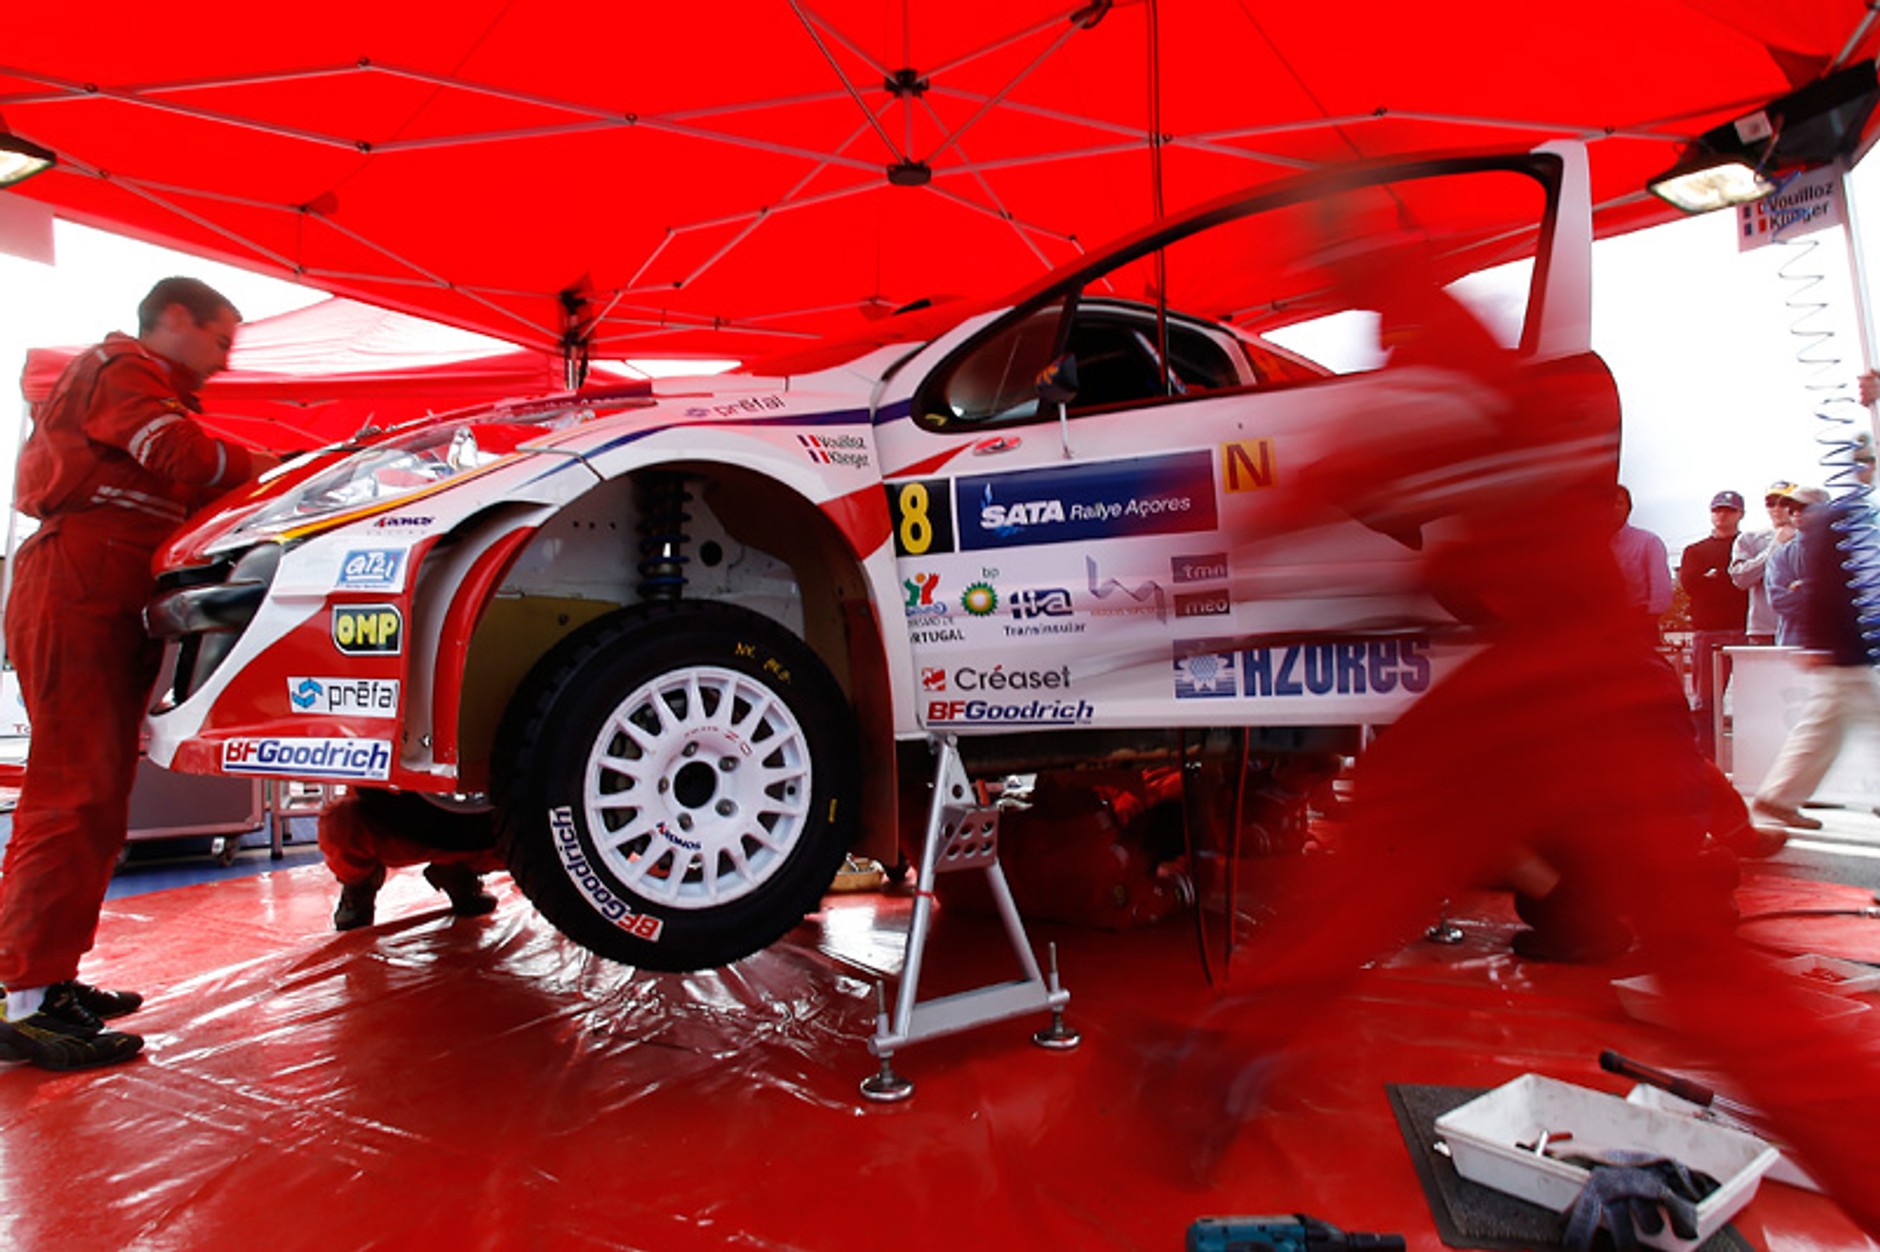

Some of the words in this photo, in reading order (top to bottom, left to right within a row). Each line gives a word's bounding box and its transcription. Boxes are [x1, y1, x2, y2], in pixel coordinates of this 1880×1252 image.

[1227, 441, 1274, 489] N
[899, 483, 933, 555] 8
[980, 500, 1065, 529] SATA
[1070, 502, 1122, 522] Rallye
[1126, 497, 1191, 516] Açores
[982, 567, 999, 579] bp
[1183, 564, 1225, 579] tmn
[337, 612, 398, 645] OMP
[1003, 621, 1086, 637] Transinsular
[954, 665, 1071, 692] Créaset
[928, 700, 1094, 720] BFGoodrich
[226, 740, 389, 769] BFGoodrich
[552, 810, 661, 939] BFGoodrich
